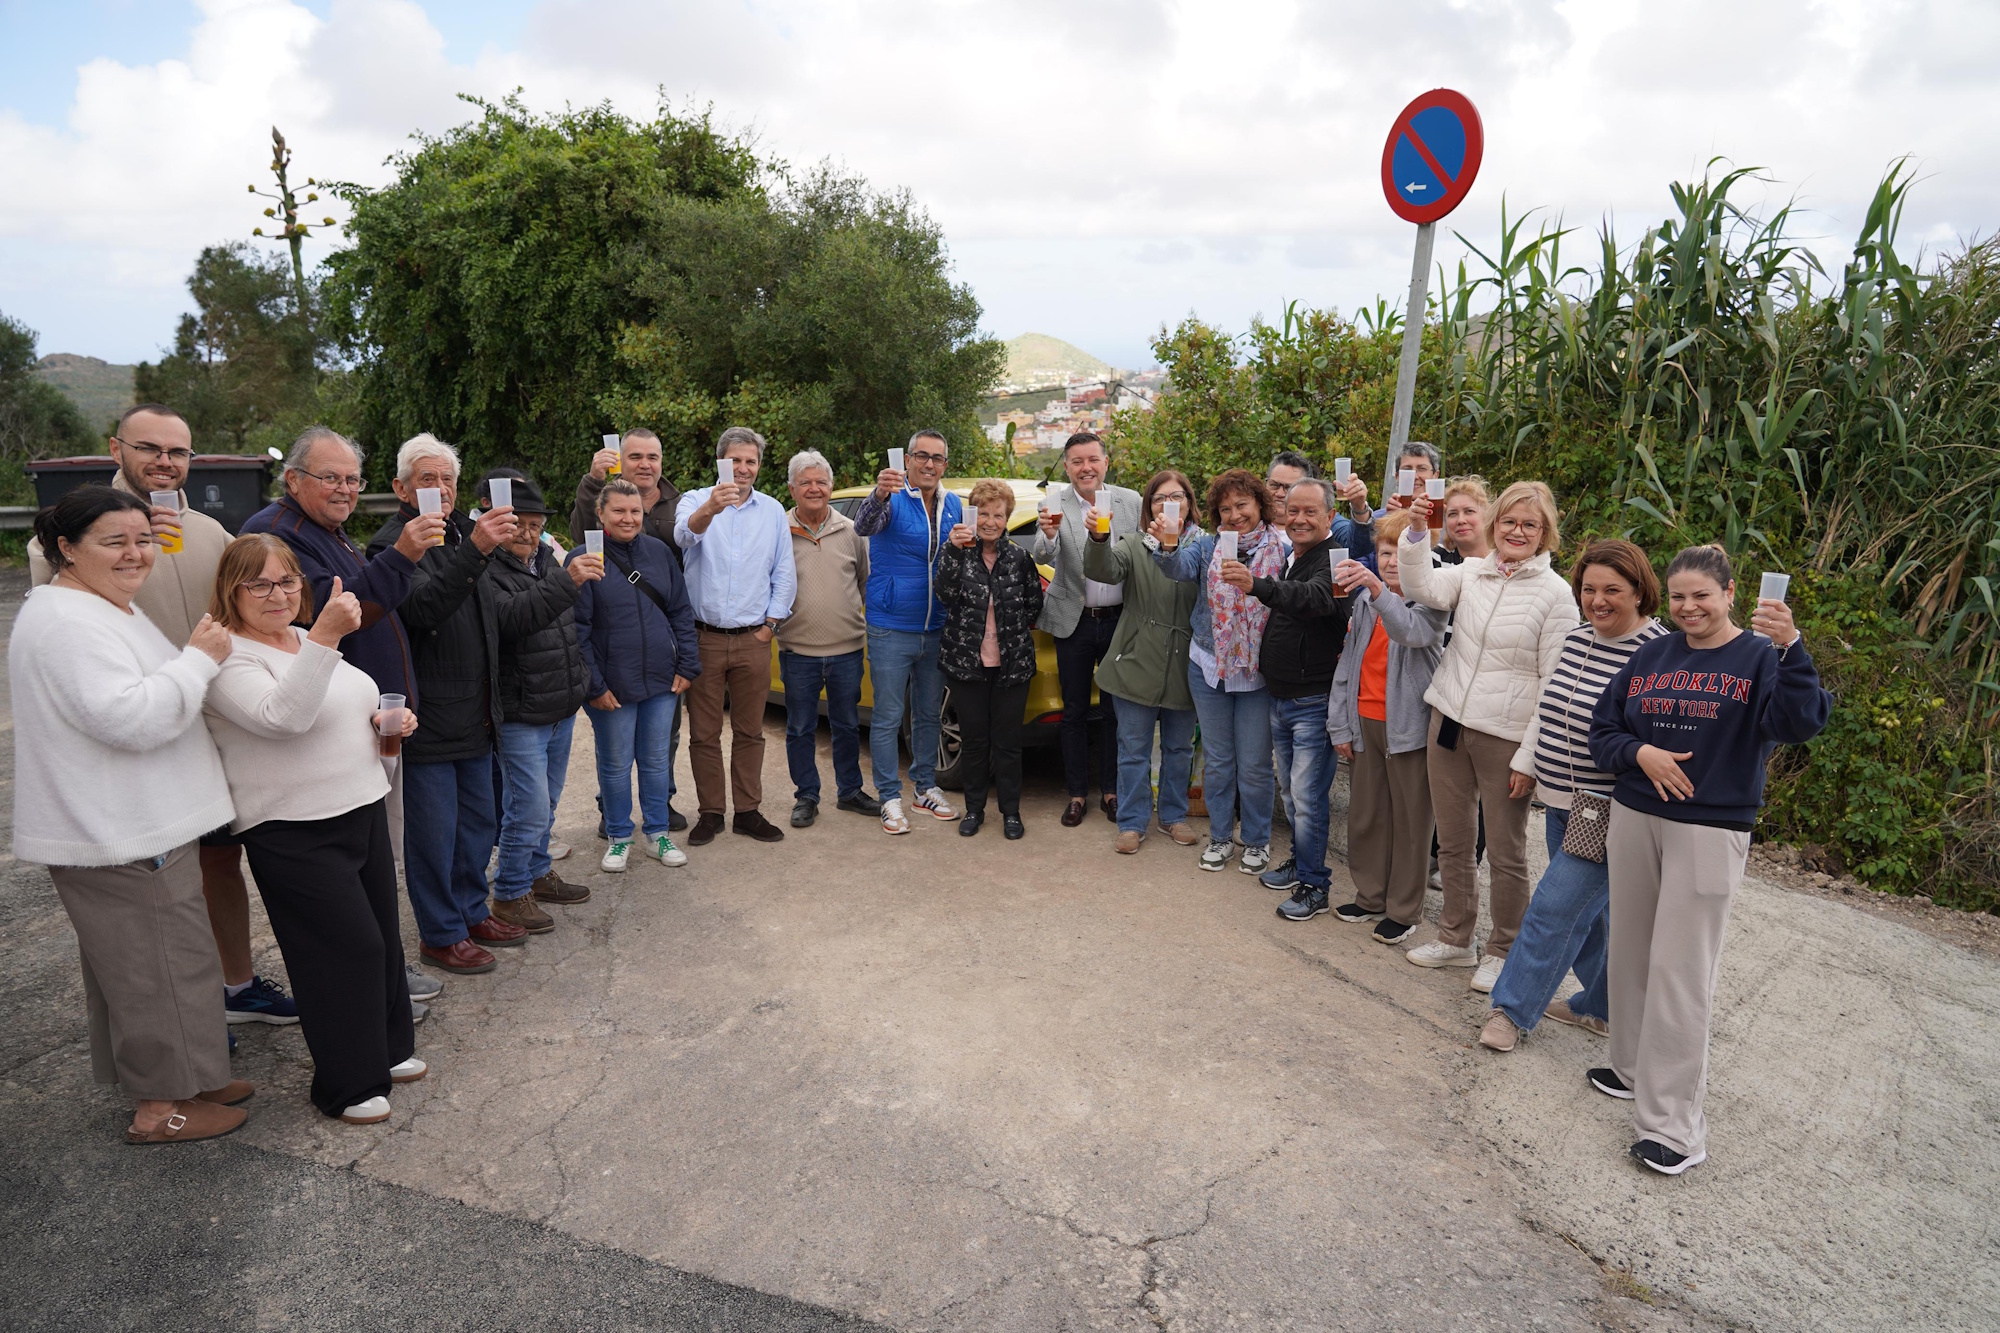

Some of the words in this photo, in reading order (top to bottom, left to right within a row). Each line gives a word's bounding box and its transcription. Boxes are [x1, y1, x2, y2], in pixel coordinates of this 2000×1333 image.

[1627, 670, 1752, 704] BROOKLYN
[1641, 697, 1676, 715] NEW
[1678, 700, 1720, 719] YORK
[1652, 721, 1677, 729] SINCE
